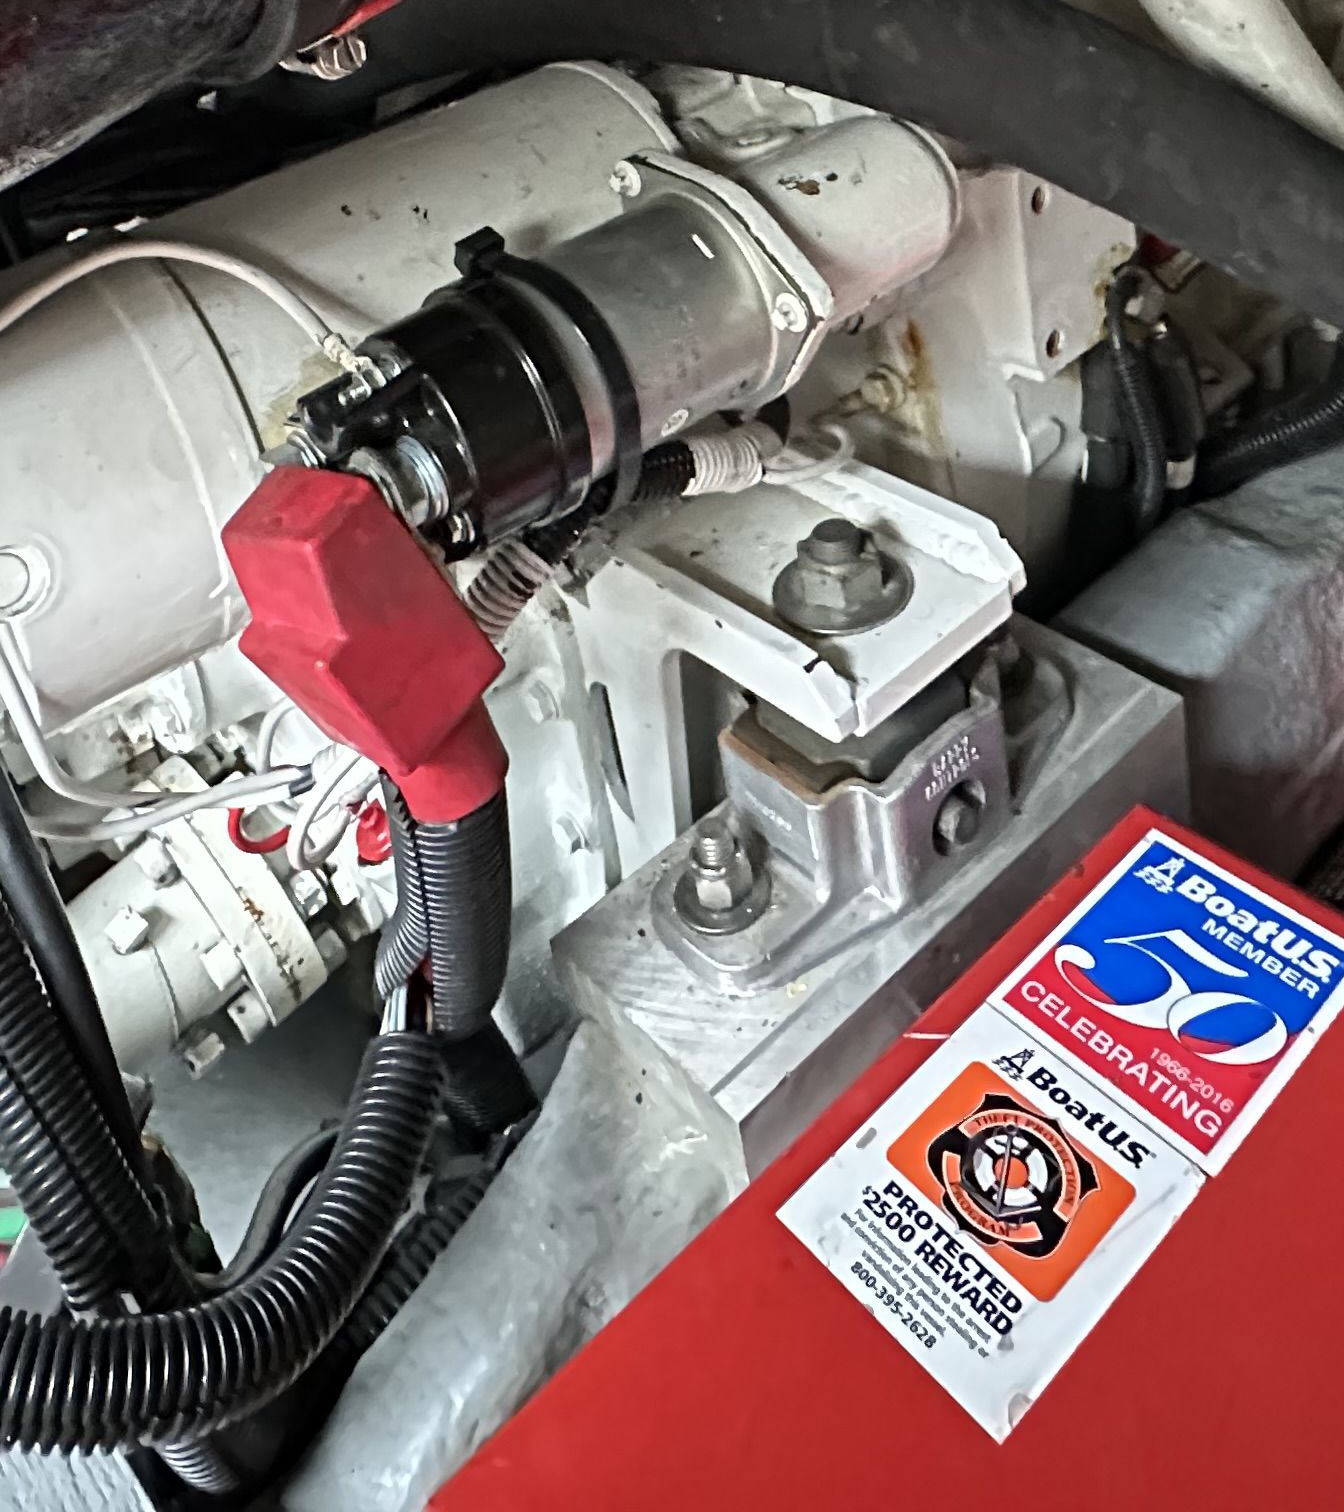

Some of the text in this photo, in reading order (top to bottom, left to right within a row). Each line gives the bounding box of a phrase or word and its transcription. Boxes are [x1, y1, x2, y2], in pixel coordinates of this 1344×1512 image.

[1054, 929, 1288, 1066] 50
[1201, 918, 1321, 1000] MEMBER
[1020, 980, 1223, 1139] CELEBRATING
[1150, 1047, 1235, 1114] 1966-2016
[850, 1260, 937, 1349] 800-395-2628
[862, 1185, 1014, 1336] $2500 REWARD
[882, 1179, 1023, 1315] PROTECTED
